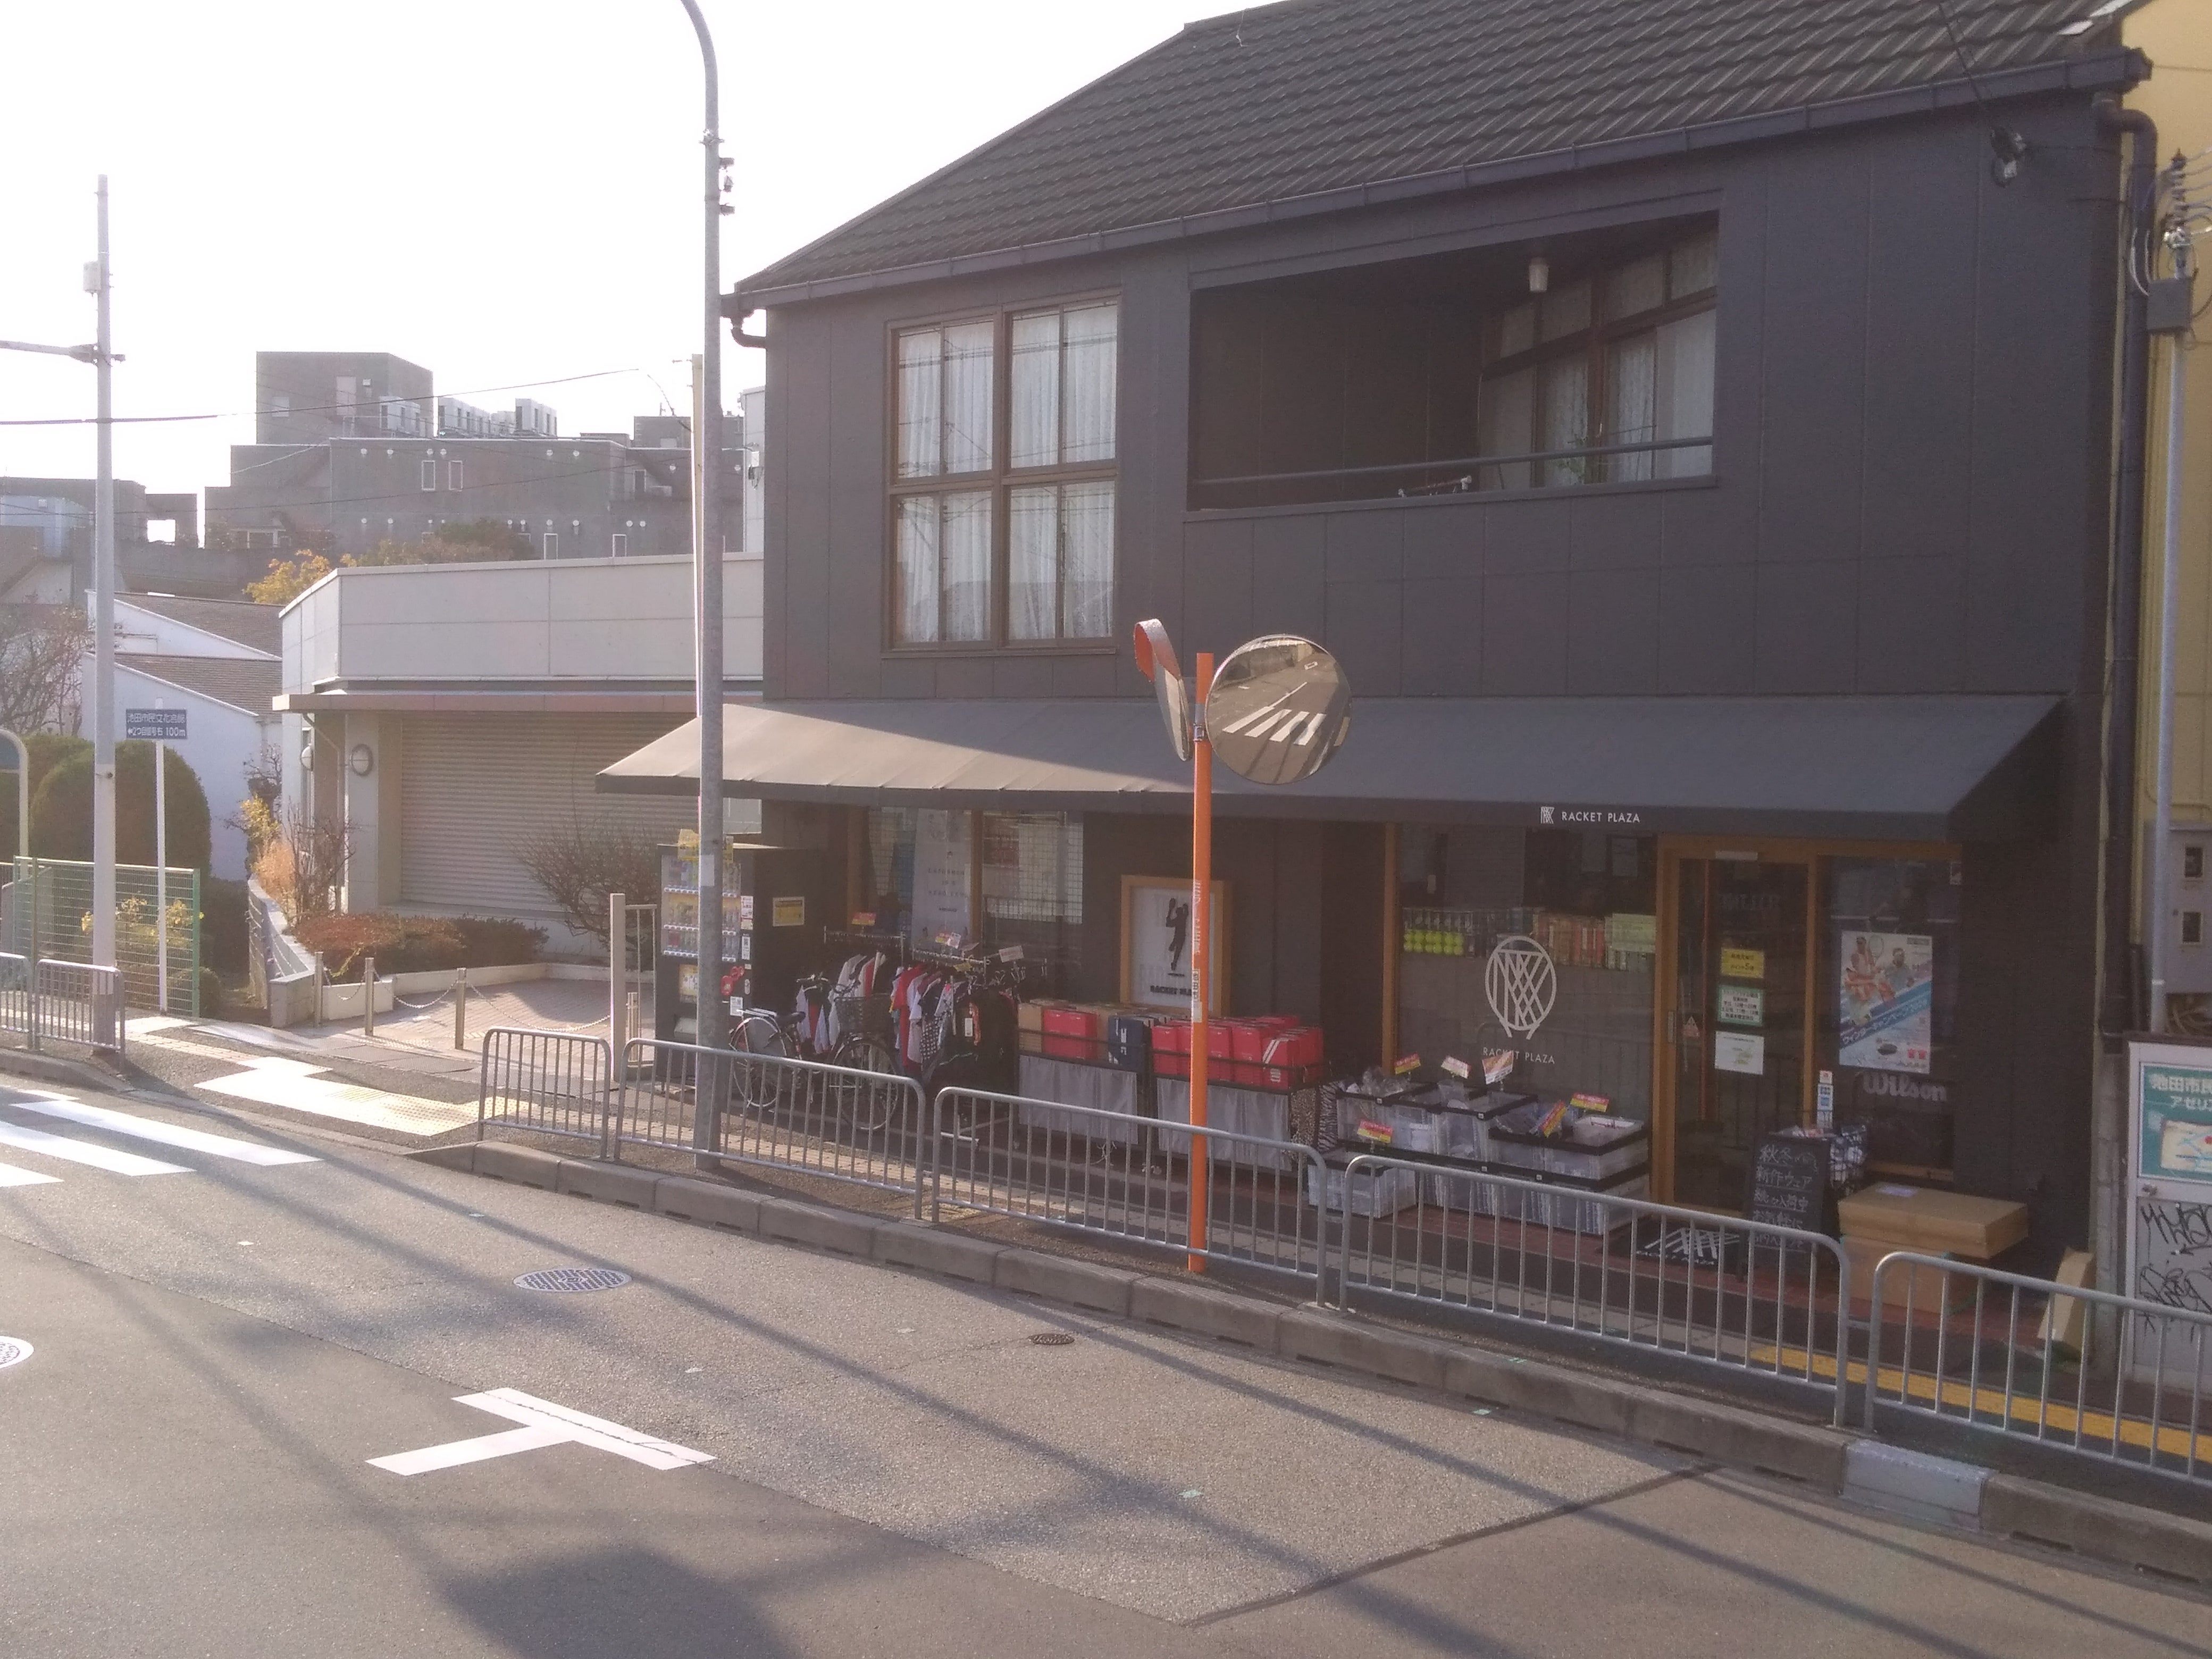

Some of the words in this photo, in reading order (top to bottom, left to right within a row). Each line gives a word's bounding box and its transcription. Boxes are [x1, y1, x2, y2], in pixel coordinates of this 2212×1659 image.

[1562, 811, 1602, 822] RACKET
[1607, 812, 1640, 823] PLAZA
[1525, 1052, 1555, 1064] PLAZA
[1861, 1071, 1947, 1101] Wilson
